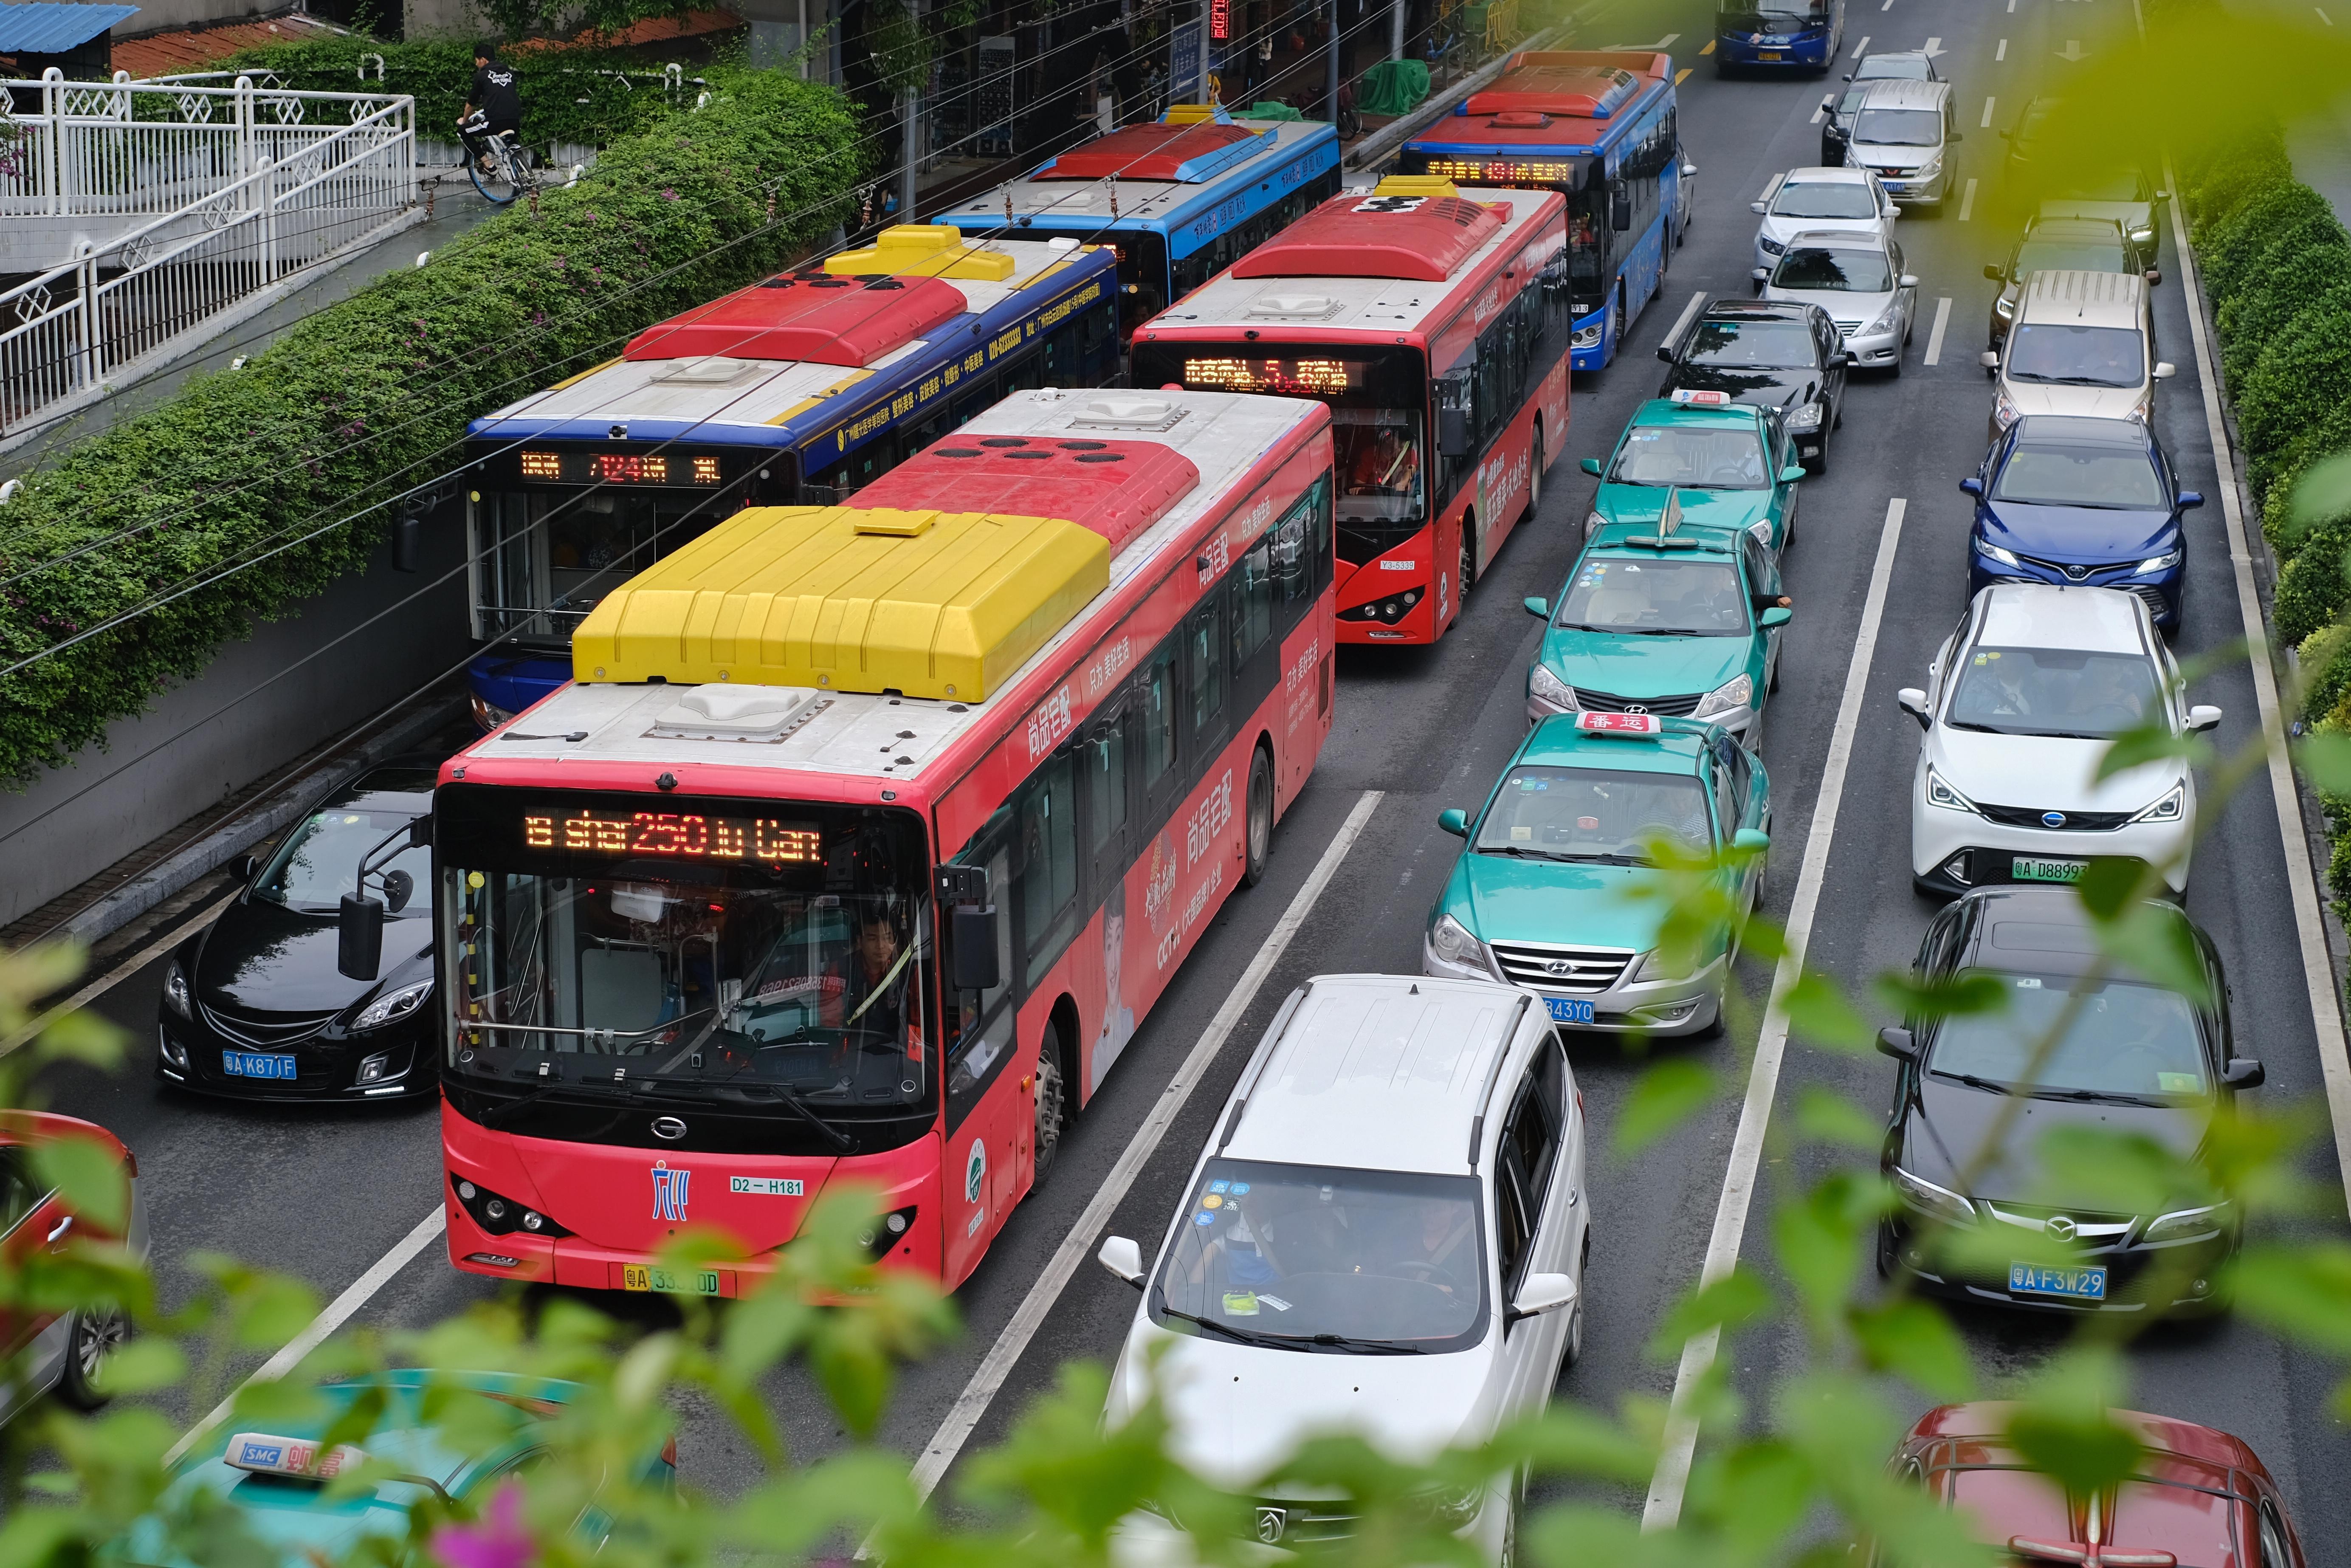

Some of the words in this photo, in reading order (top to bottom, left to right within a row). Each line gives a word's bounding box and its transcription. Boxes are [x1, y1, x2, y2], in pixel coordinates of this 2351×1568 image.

[1028, 685, 1071, 762] 尚品宅配
[1104, 636, 1129, 681] 美好生活
[633, 813, 707, 853] 250
[1187, 768, 1232, 874] 尚品宅配
[247, 1448, 278, 1463] SMC
